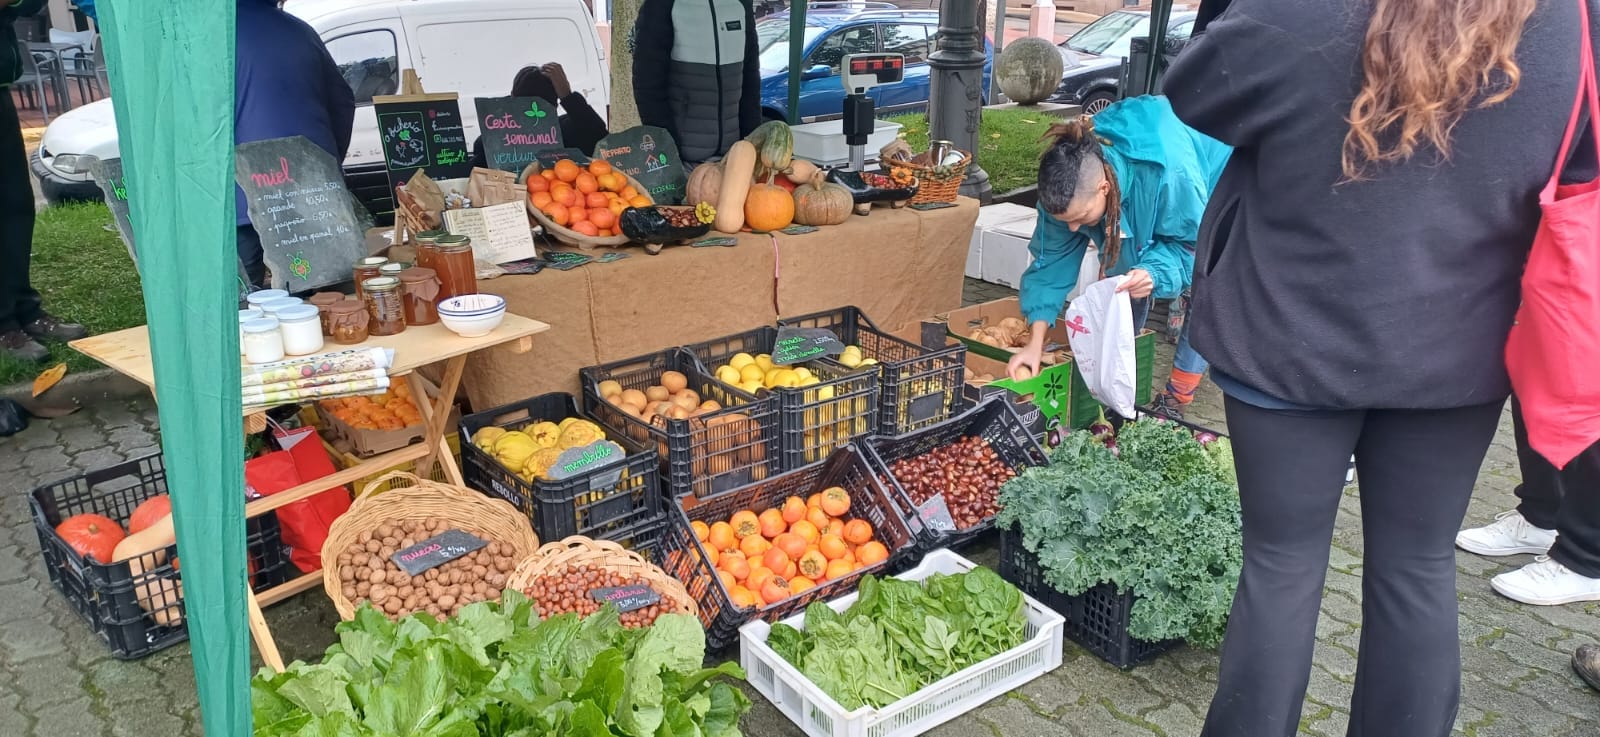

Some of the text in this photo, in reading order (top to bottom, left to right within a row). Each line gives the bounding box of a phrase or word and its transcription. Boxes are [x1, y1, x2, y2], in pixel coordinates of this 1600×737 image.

[485, 112, 522, 129] Cesta
[503, 126, 559, 146] semanal
[251, 156, 295, 188] miel
[263, 189, 284, 201] miel
[267, 199, 296, 221] grande
[281, 233, 299, 246] miel
[491, 479, 520, 506] REBOLLO
